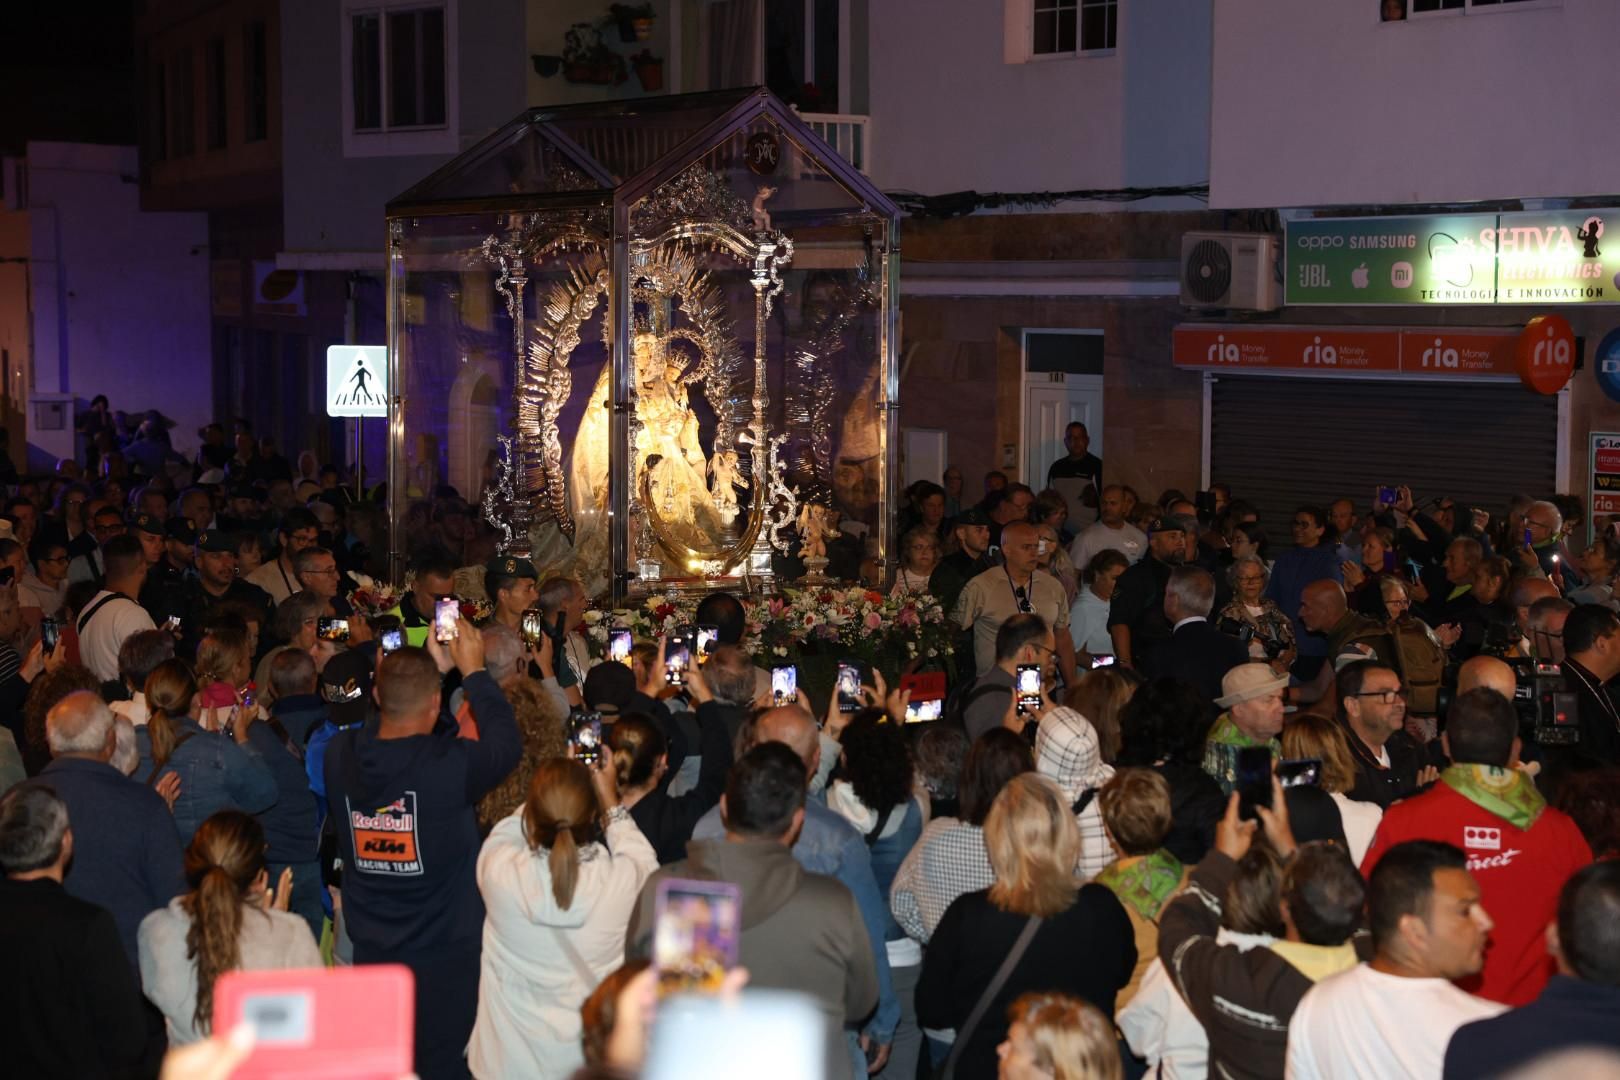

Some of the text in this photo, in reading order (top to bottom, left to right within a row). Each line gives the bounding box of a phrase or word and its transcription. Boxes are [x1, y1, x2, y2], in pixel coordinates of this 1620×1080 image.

[1298, 235, 1344, 250] oppo
[1350, 234, 1416, 249] SAMSUNG
[1299, 264, 1331, 288] JBL
[1507, 288, 1513, 298] E
[1520, 285, 1603, 298] INNOVACIÓN
[1208, 334, 1240, 362] ria
[1242, 344, 1265, 354] Money
[1303, 336, 1337, 365] ria
[1339, 346, 1365, 356] Money
[1422, 338, 1459, 368] ria
[1534, 326, 1569, 366] ria
[1462, 350, 1490, 360] Money
[1462, 359, 1494, 369] Transfer
[1594, 496, 1613, 510] ria
[352, 811, 413, 832] Red Bull
[364, 837, 406, 854] KTM
[358, 859, 419, 872] RACING TEAM
